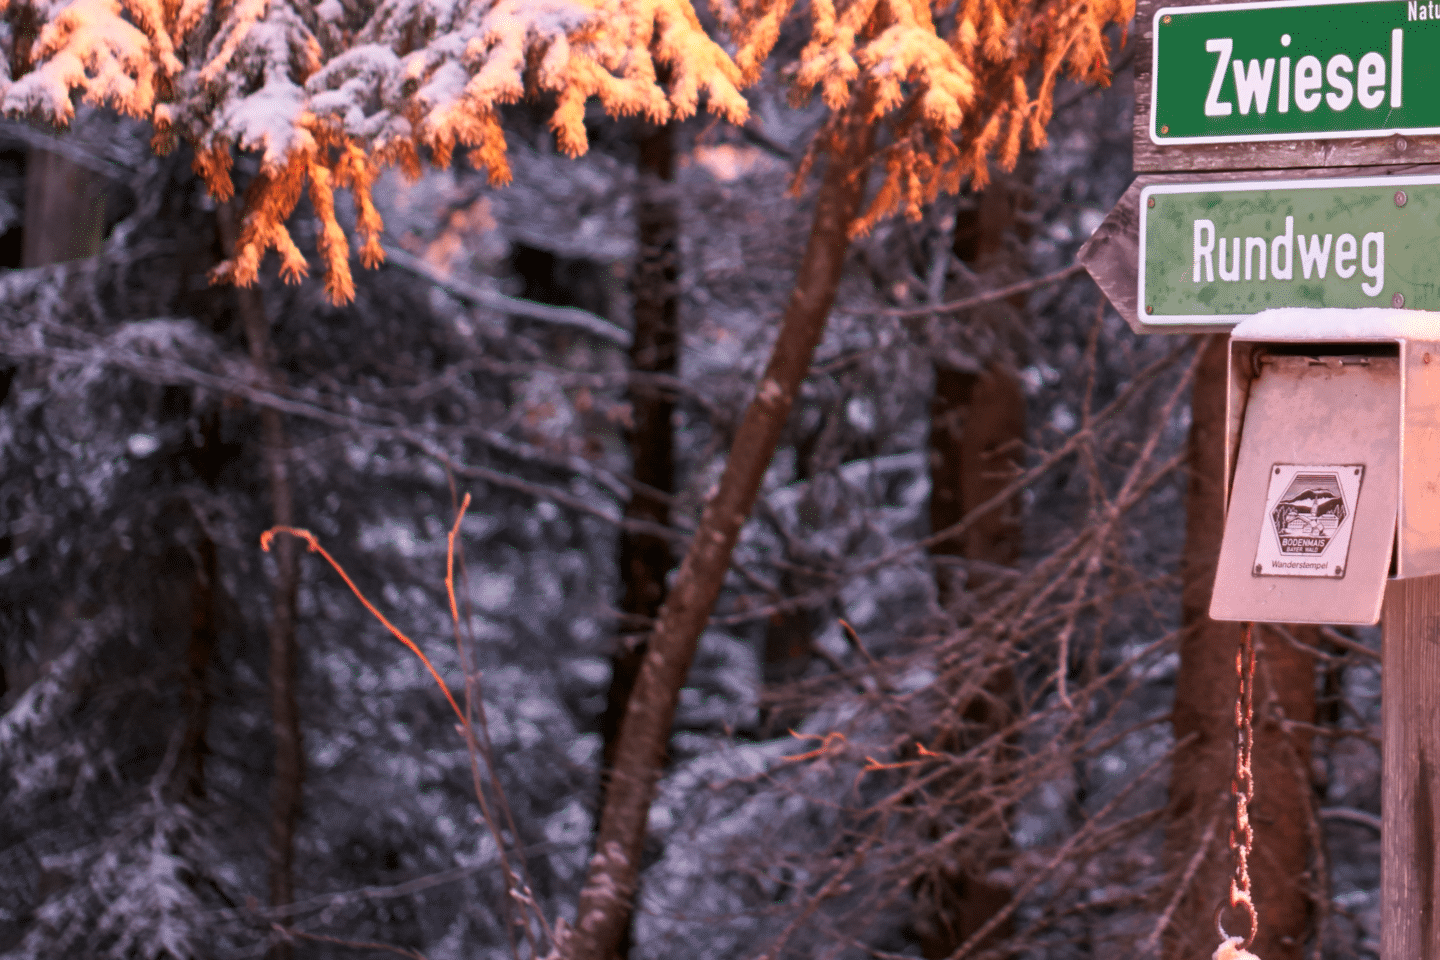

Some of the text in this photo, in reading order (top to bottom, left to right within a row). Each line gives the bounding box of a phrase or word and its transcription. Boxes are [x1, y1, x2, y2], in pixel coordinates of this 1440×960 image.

[1204, 27, 1403, 117] Zwiesel
[1192, 216, 1385, 297] Rundweg
[1271, 560, 1329, 570] Wanderstempel
[1282, 538, 1325, 547] BODENMAIS
